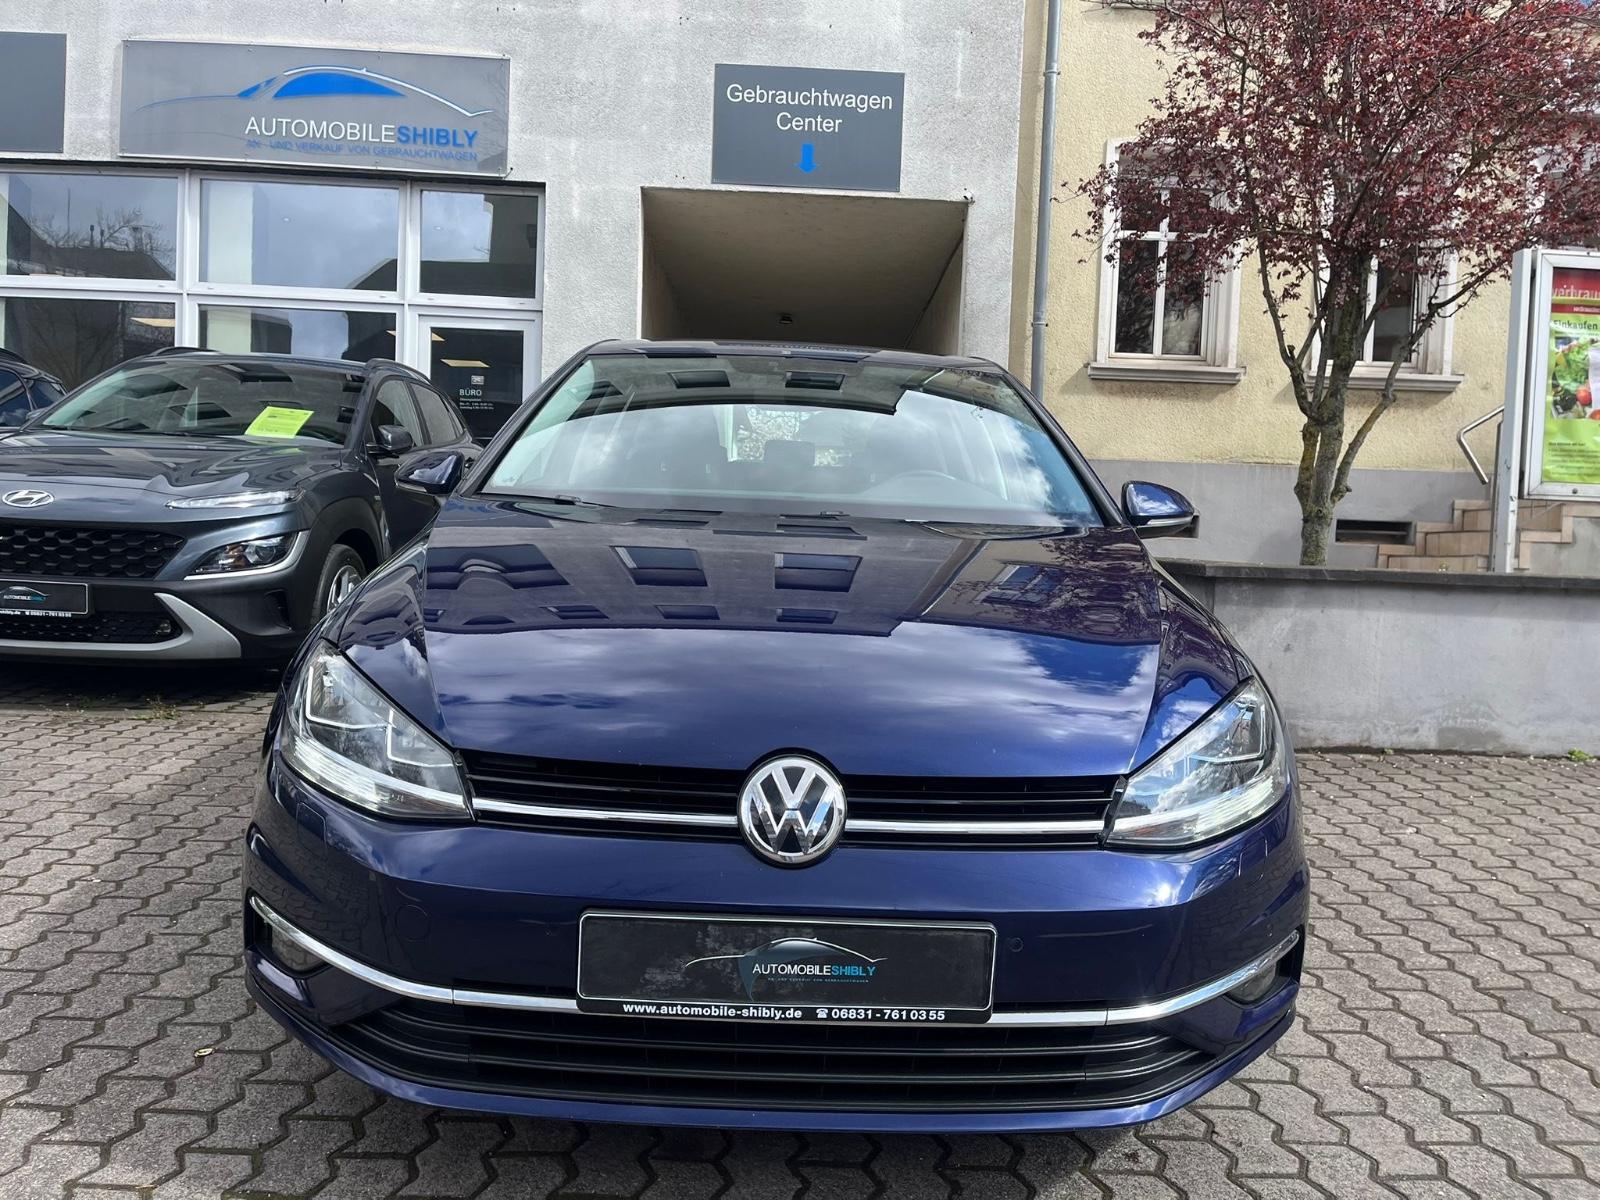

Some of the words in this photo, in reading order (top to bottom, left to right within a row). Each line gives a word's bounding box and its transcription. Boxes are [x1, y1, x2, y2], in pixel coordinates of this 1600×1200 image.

[726, 84, 893, 113] Gebrauchtwagen
[776, 112, 842, 132] Center
[349, 144, 370, 155] VON
[459, 387, 482, 397] BÜRO
[622, 1003, 803, 1021] www.automobile-shibly.de
